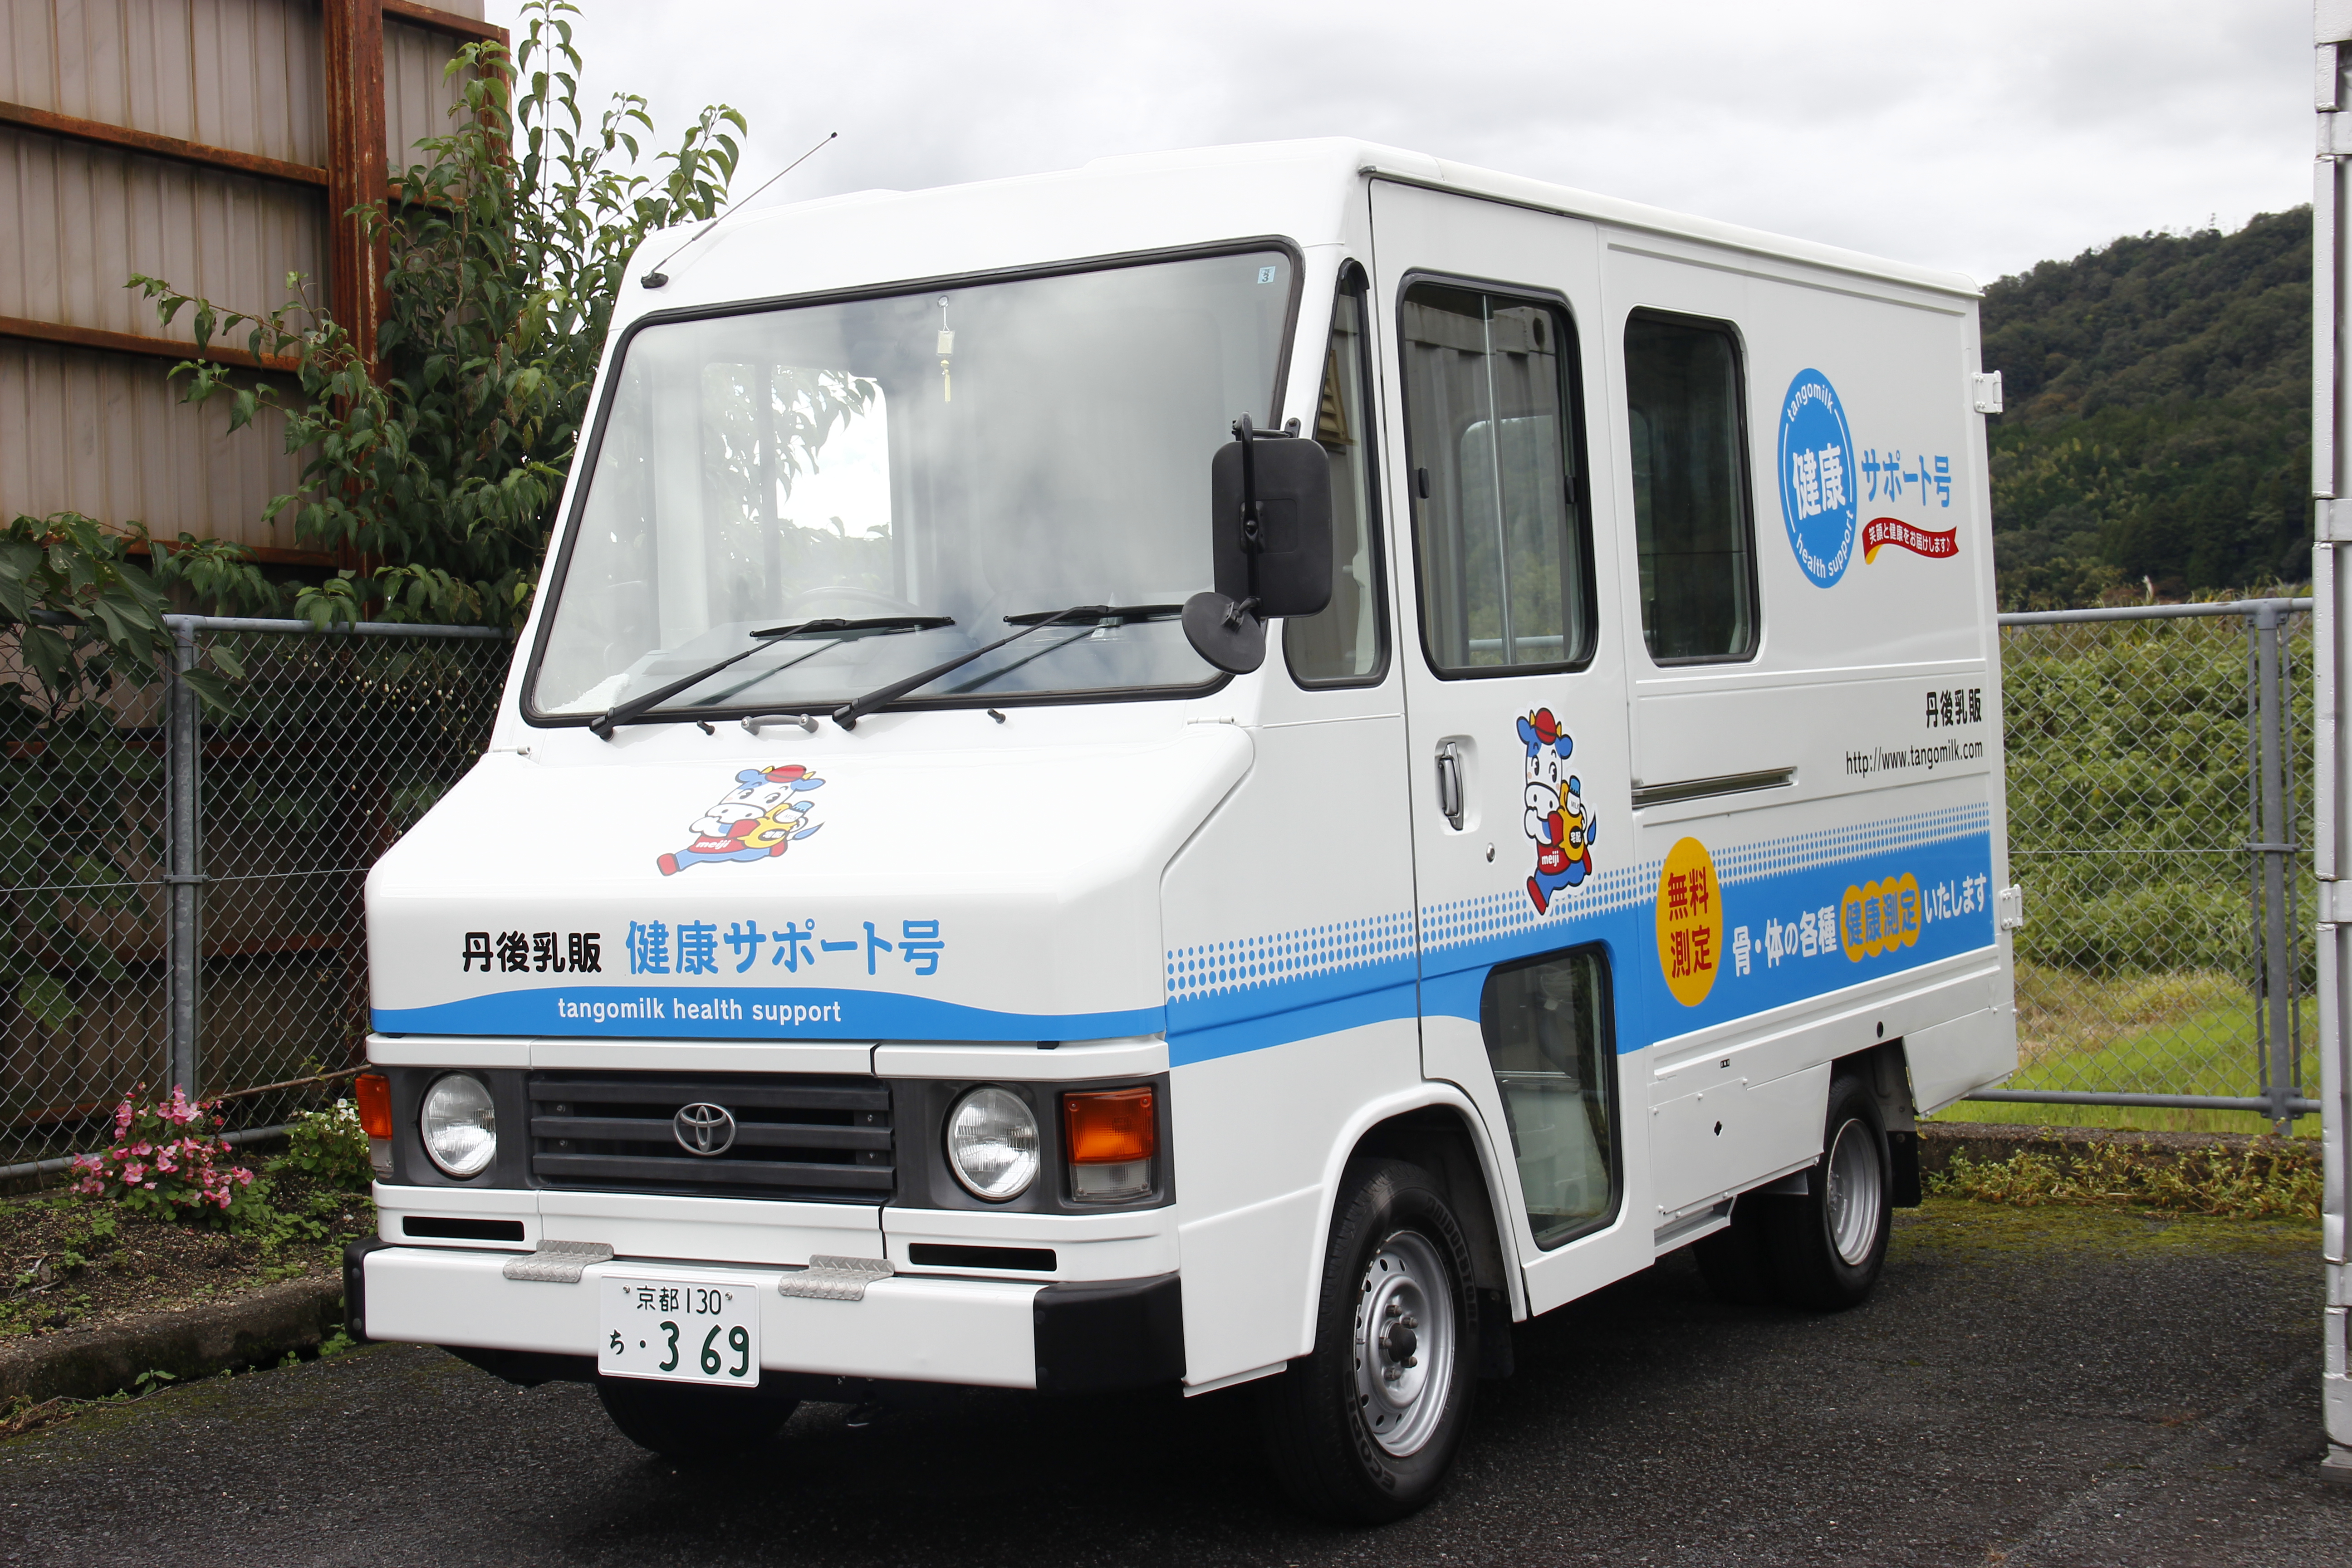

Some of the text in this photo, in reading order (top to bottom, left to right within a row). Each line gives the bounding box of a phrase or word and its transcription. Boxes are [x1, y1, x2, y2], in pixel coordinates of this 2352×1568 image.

[1787, 383, 1834, 422] tangomilk
[1793, 442, 1951, 520] 健康 サポート号
[1796, 510, 1854, 578] health support
[1926, 688, 1982, 728] 丹後乳販
[1846, 739, 1983, 779] http://www.tangomilk.com
[695, 839, 731, 850] meiji
[1541, 850, 1559, 866] meiji
[1667, 866, 1709, 922] 無料
[462, 918, 945, 976] 丹後乳販 健康サポート号
[1670, 924, 1713, 980] 測定
[558, 998, 842, 1026] tangomilk health support
